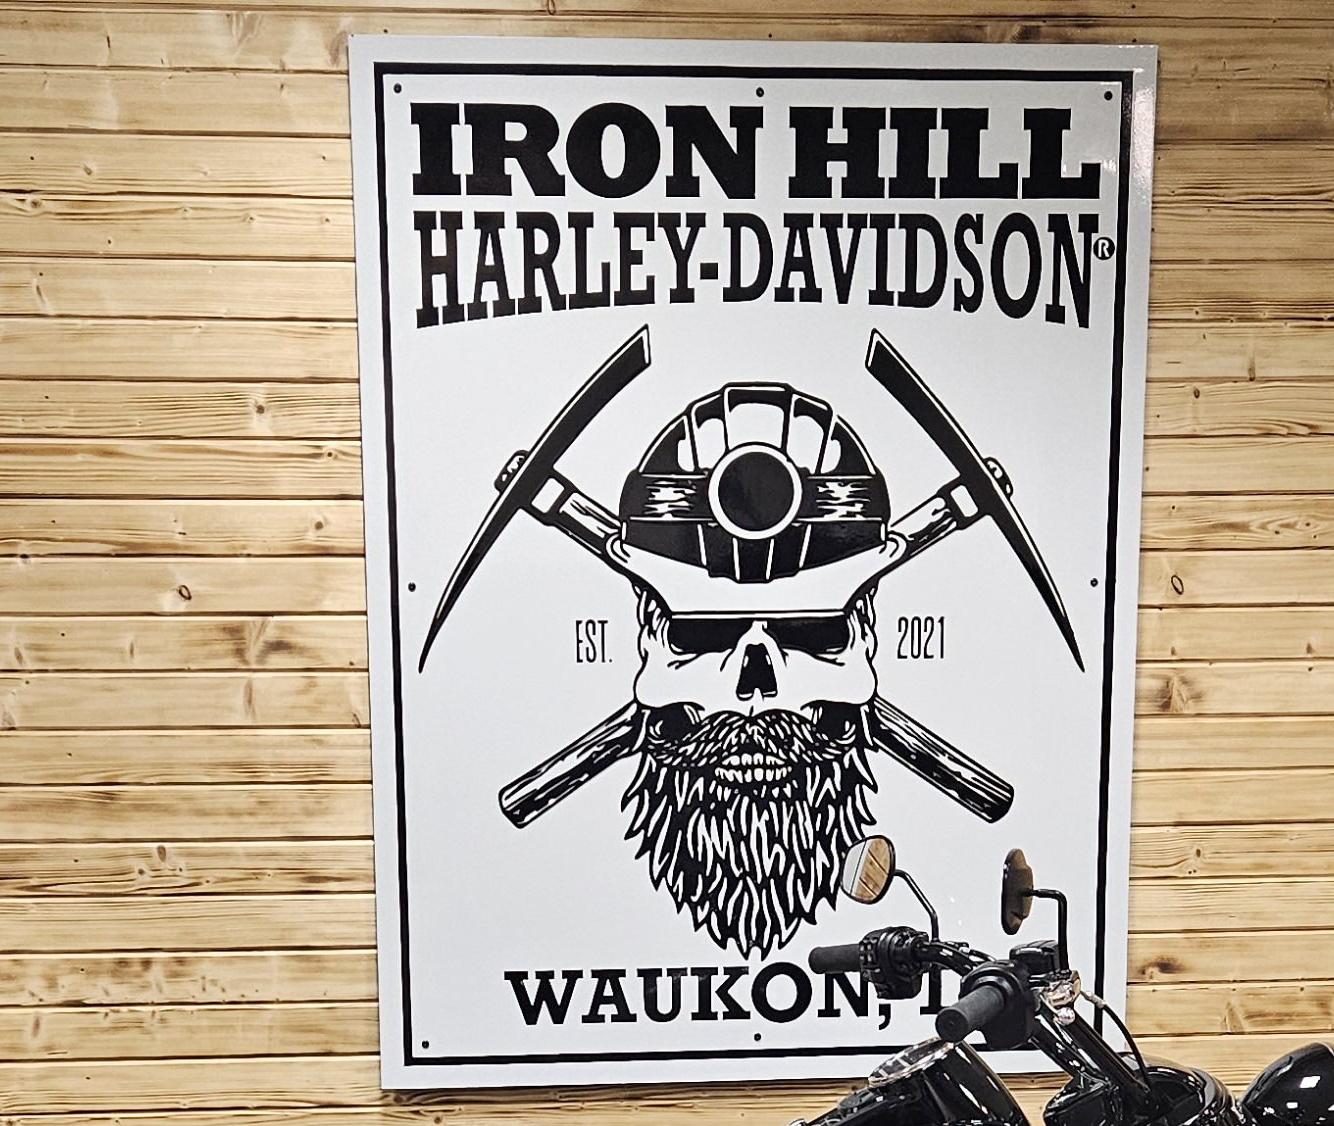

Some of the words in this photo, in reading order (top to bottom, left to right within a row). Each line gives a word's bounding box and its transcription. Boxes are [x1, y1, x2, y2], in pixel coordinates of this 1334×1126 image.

[410, 102, 764, 199] IRON
[789, 106, 1101, 199] HILL
[575, 619, 613, 663] EST.
[897, 616, 945, 660] 2021
[504, 961, 891, 1030] WAUKON,
